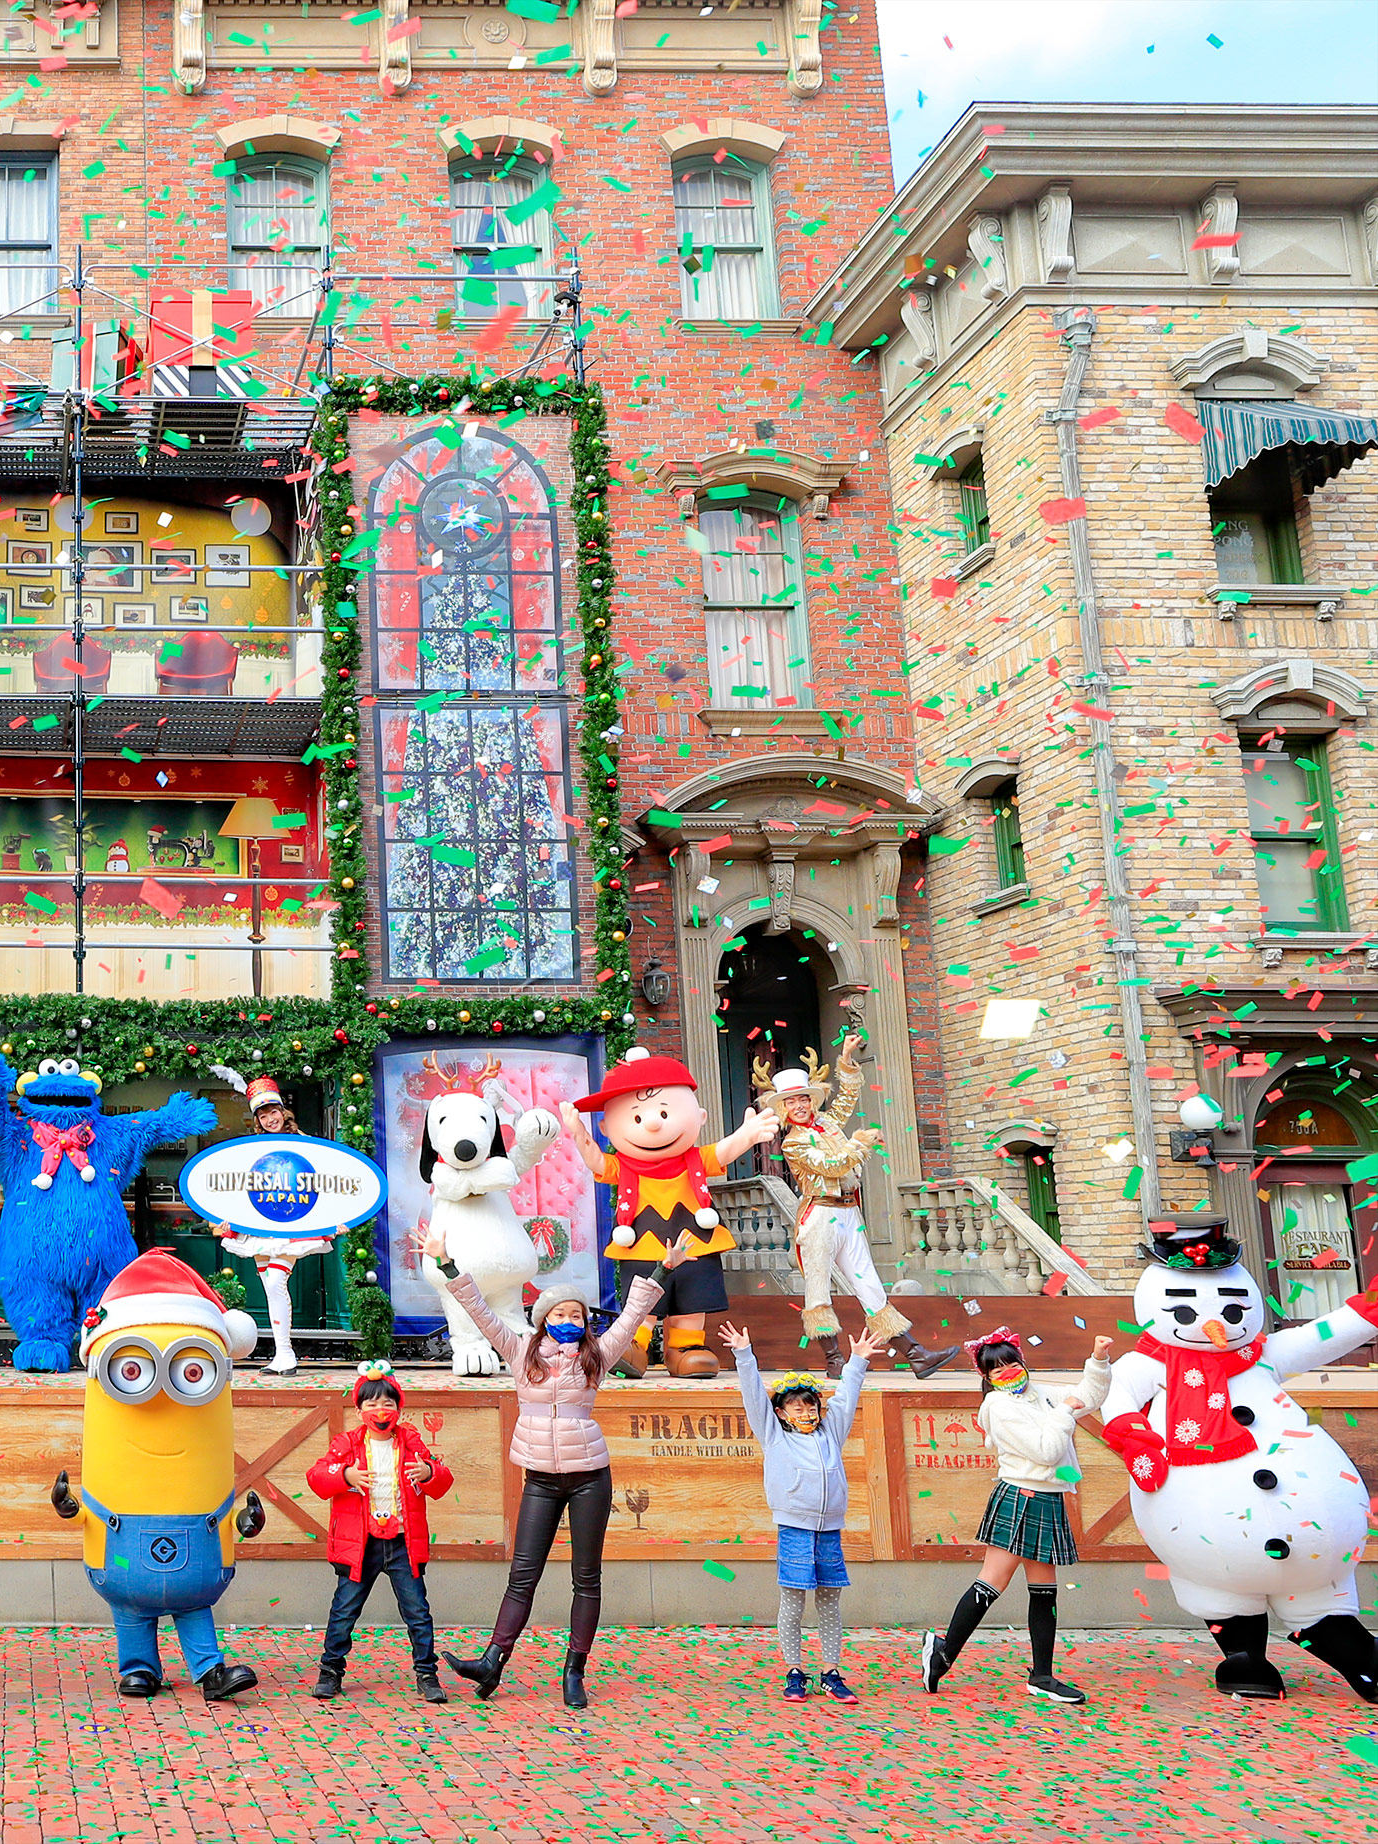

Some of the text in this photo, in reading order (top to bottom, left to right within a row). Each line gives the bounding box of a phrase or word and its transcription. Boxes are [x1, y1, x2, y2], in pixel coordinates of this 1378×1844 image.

[206, 1171, 363, 1196] UNIVERSAL STUDIOS
[258, 1193, 309, 1204] JAPAN
[629, 1414, 754, 1440] FRAGIL
[651, 1445, 755, 1457] HANDLE WITH CARE
[914, 1454, 997, 1468] FRAGILE
